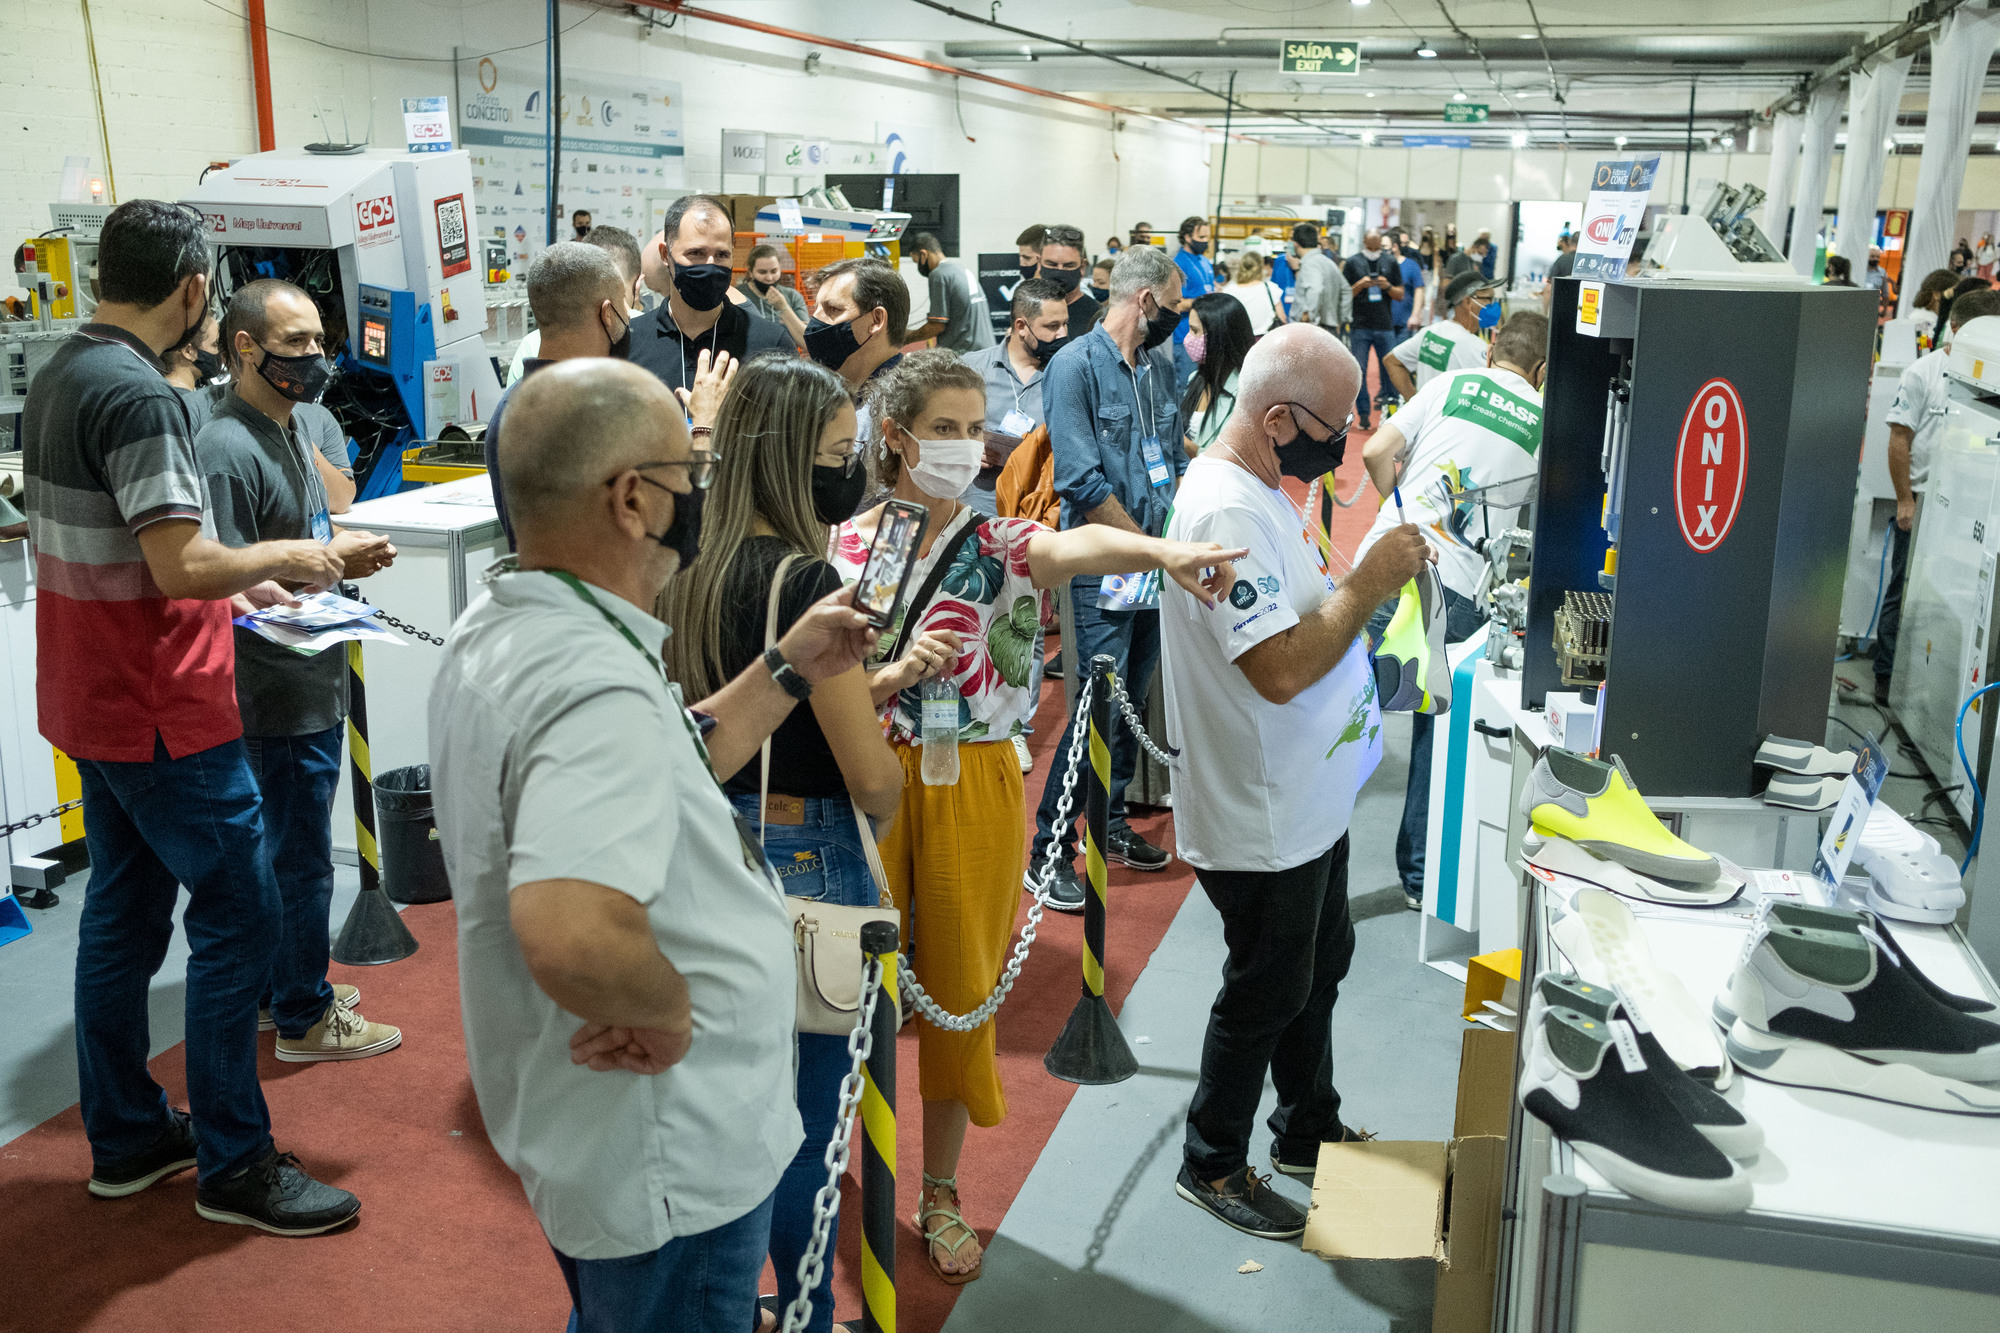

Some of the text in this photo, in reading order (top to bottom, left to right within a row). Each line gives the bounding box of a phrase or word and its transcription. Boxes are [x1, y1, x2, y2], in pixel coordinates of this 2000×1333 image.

[1287, 42, 1333, 59] SAÍDA
[1296, 60, 1323, 71] EXIT
[466, 103, 509, 122] CONCEITO
[1610, 175, 1629, 185] CONCE
[233, 217, 255, 231] Map
[256, 218, 302, 231] Universal
[1594, 221, 1613, 238] ONI
[1489, 391, 1540, 427] BASF
[1457, 397, 1533, 440] We create chemistry
[1694, 395, 1727, 537] ONIX
[1973, 520, 1985, 544] 650
